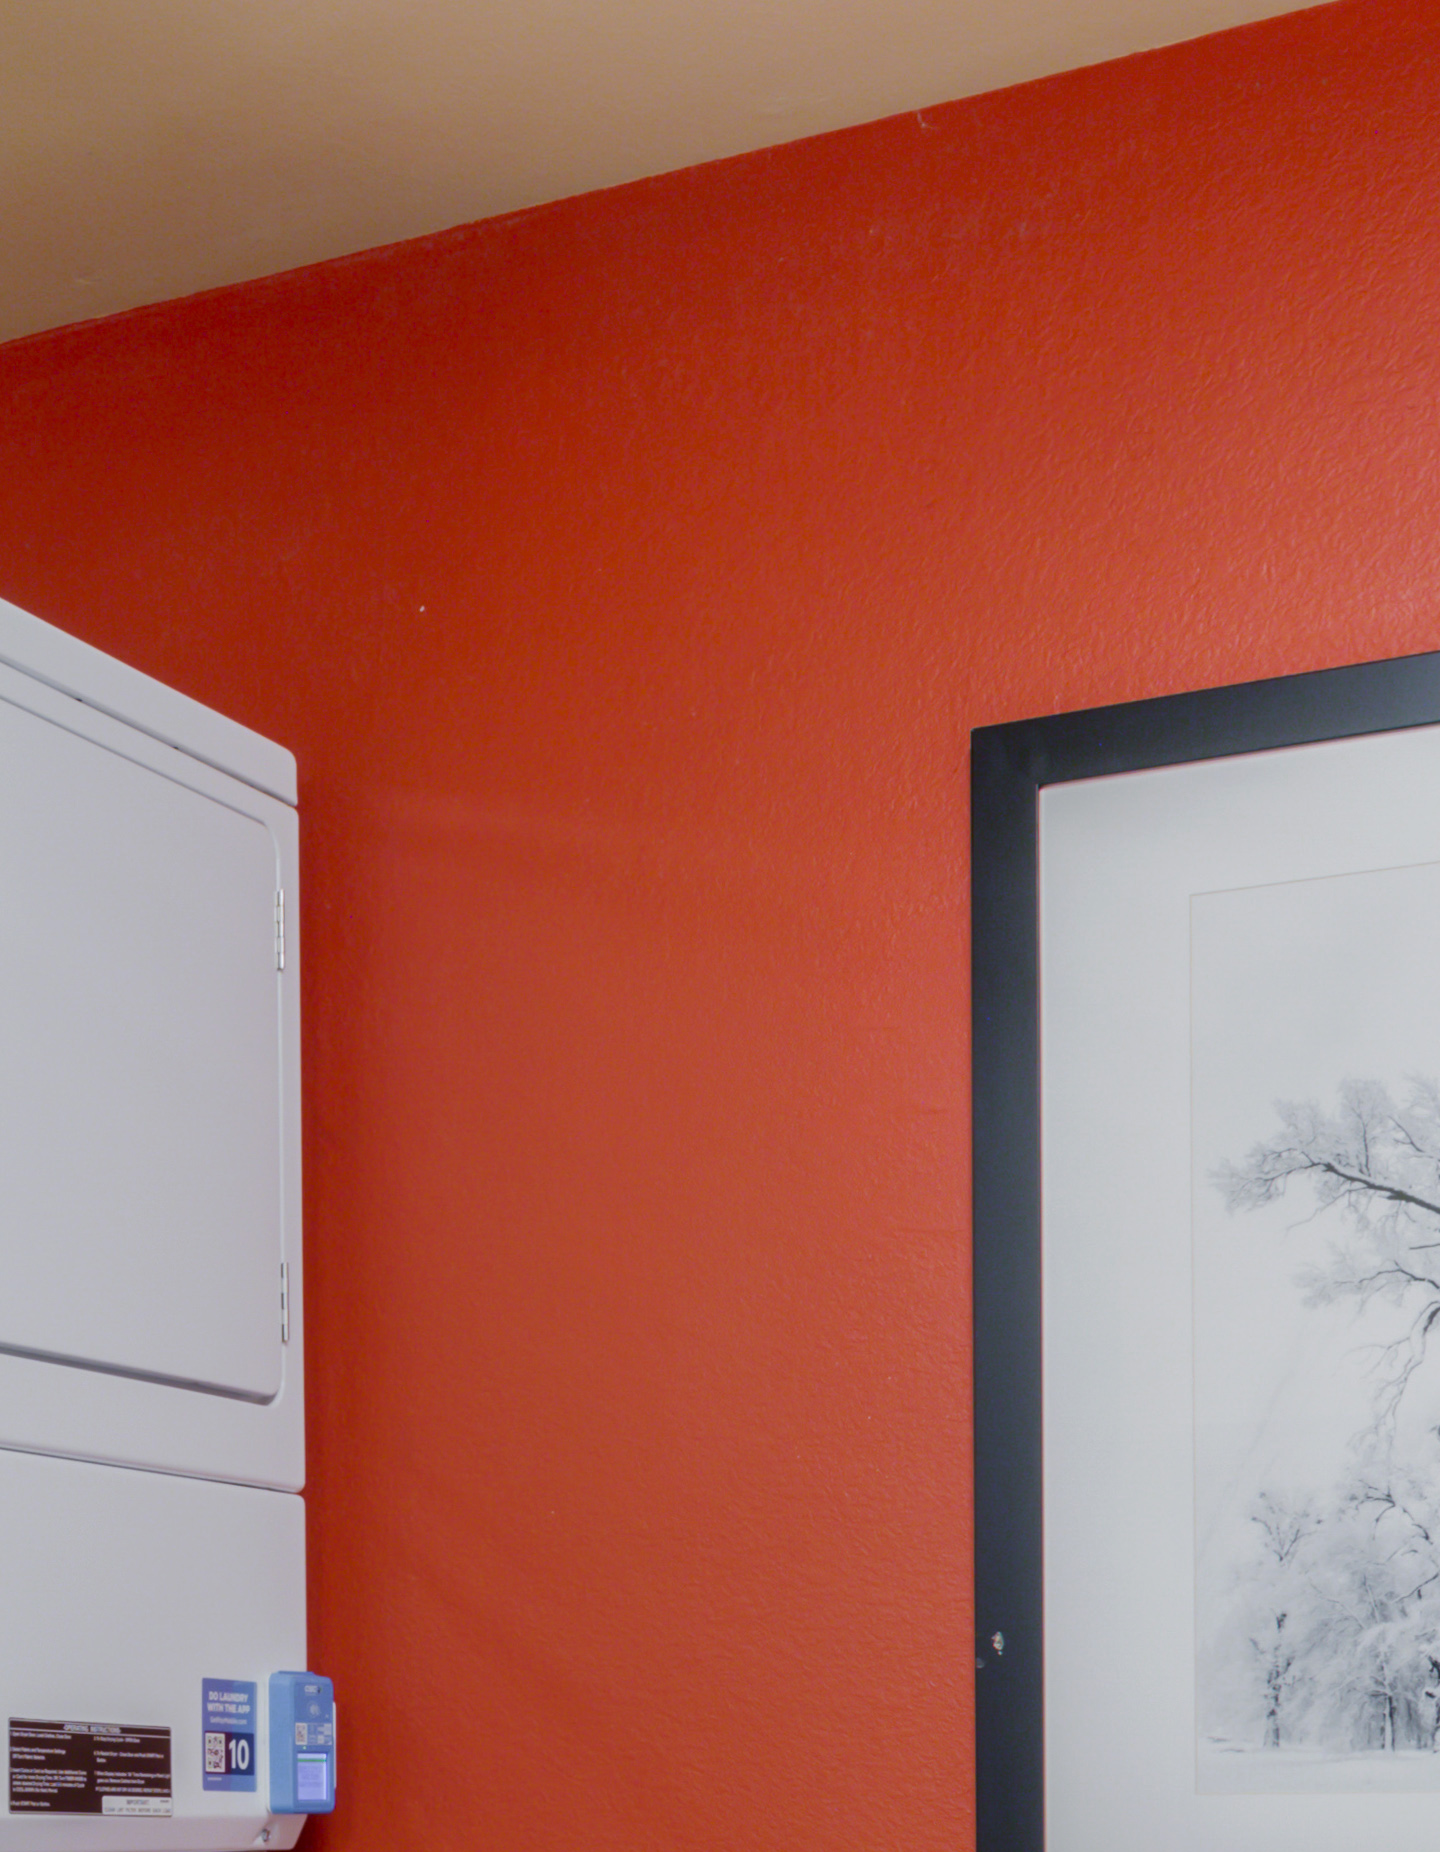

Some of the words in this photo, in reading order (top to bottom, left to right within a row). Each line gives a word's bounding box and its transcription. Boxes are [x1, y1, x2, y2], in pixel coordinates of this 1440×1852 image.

[209, 1691, 218, 1700] DO
[220, 1692, 248, 1702] LAUNDRY
[207, 1703, 223, 1711] WITH
[225, 1704, 236, 1712] THE
[237, 1704, 250, 1713] APP
[228, 1739, 249, 1770] 10
